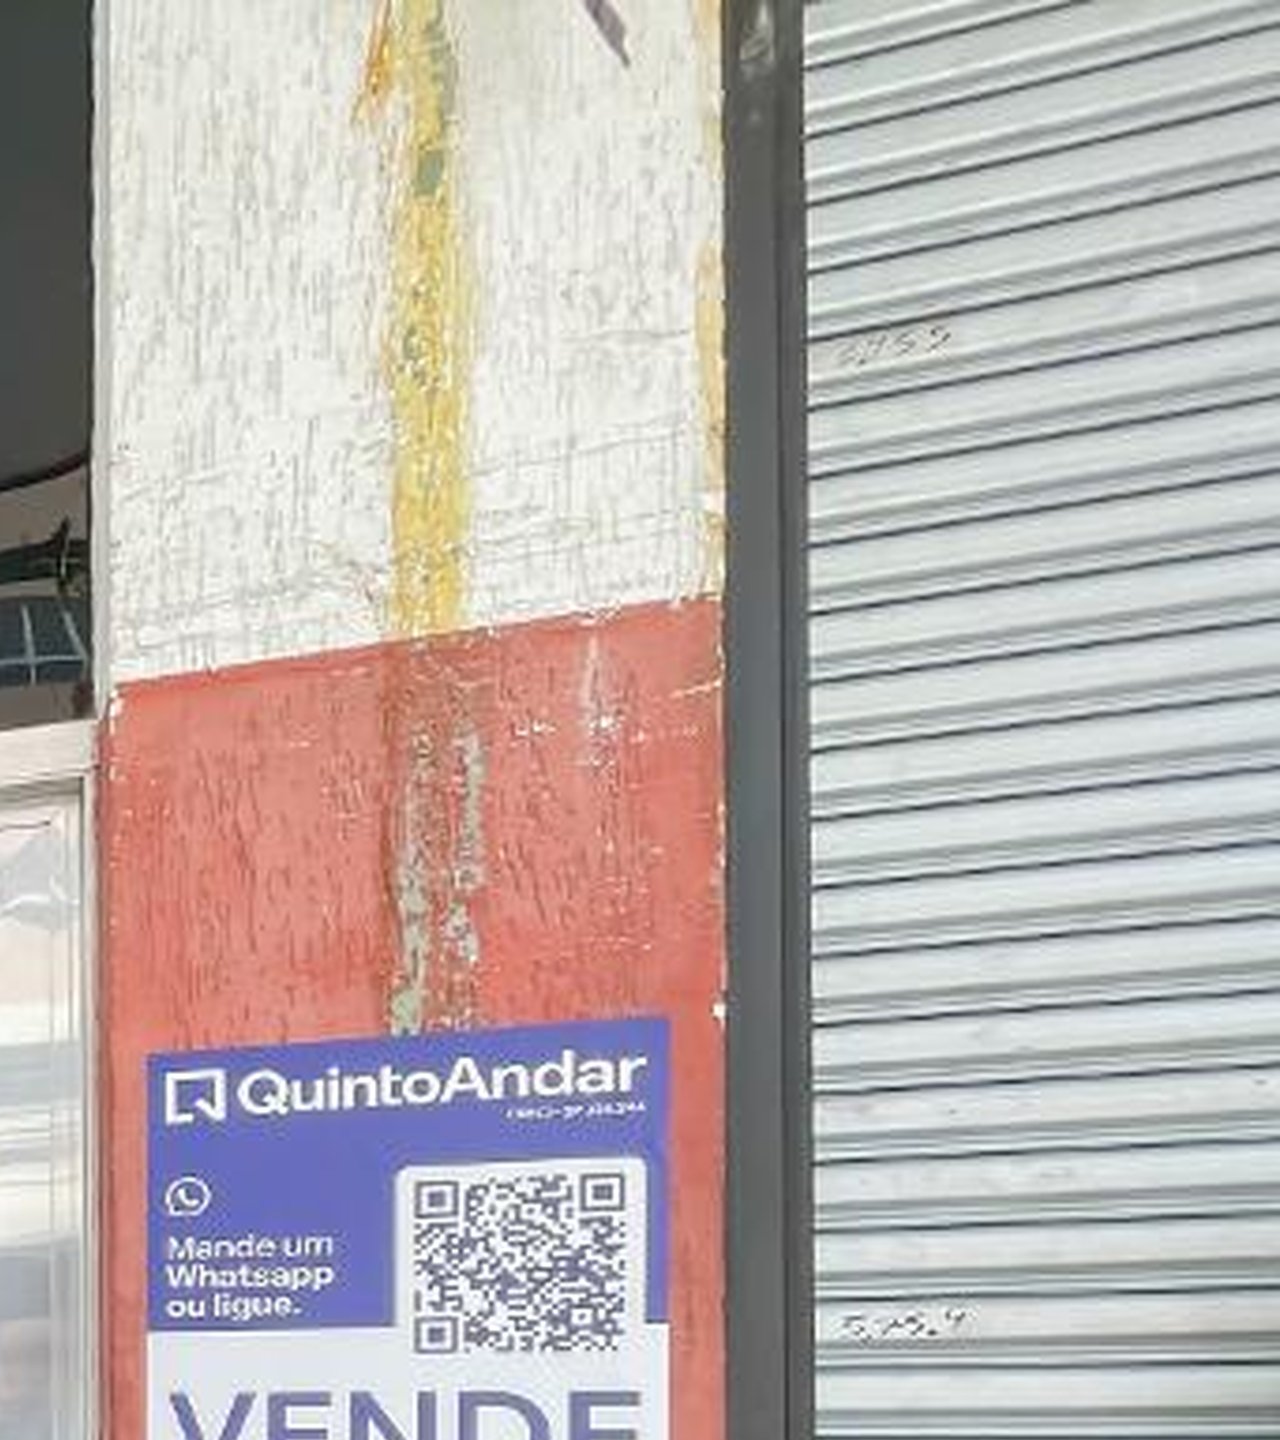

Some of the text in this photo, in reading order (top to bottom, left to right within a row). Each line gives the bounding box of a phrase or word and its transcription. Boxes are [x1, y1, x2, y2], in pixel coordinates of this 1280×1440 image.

[237, 1049, 648, 1115] QuintoAndar
[168, 1234, 333, 1260] Mande um
[166, 1263, 335, 1291] Whatsapp
[166, 1293, 303, 1322] ou ligue.
